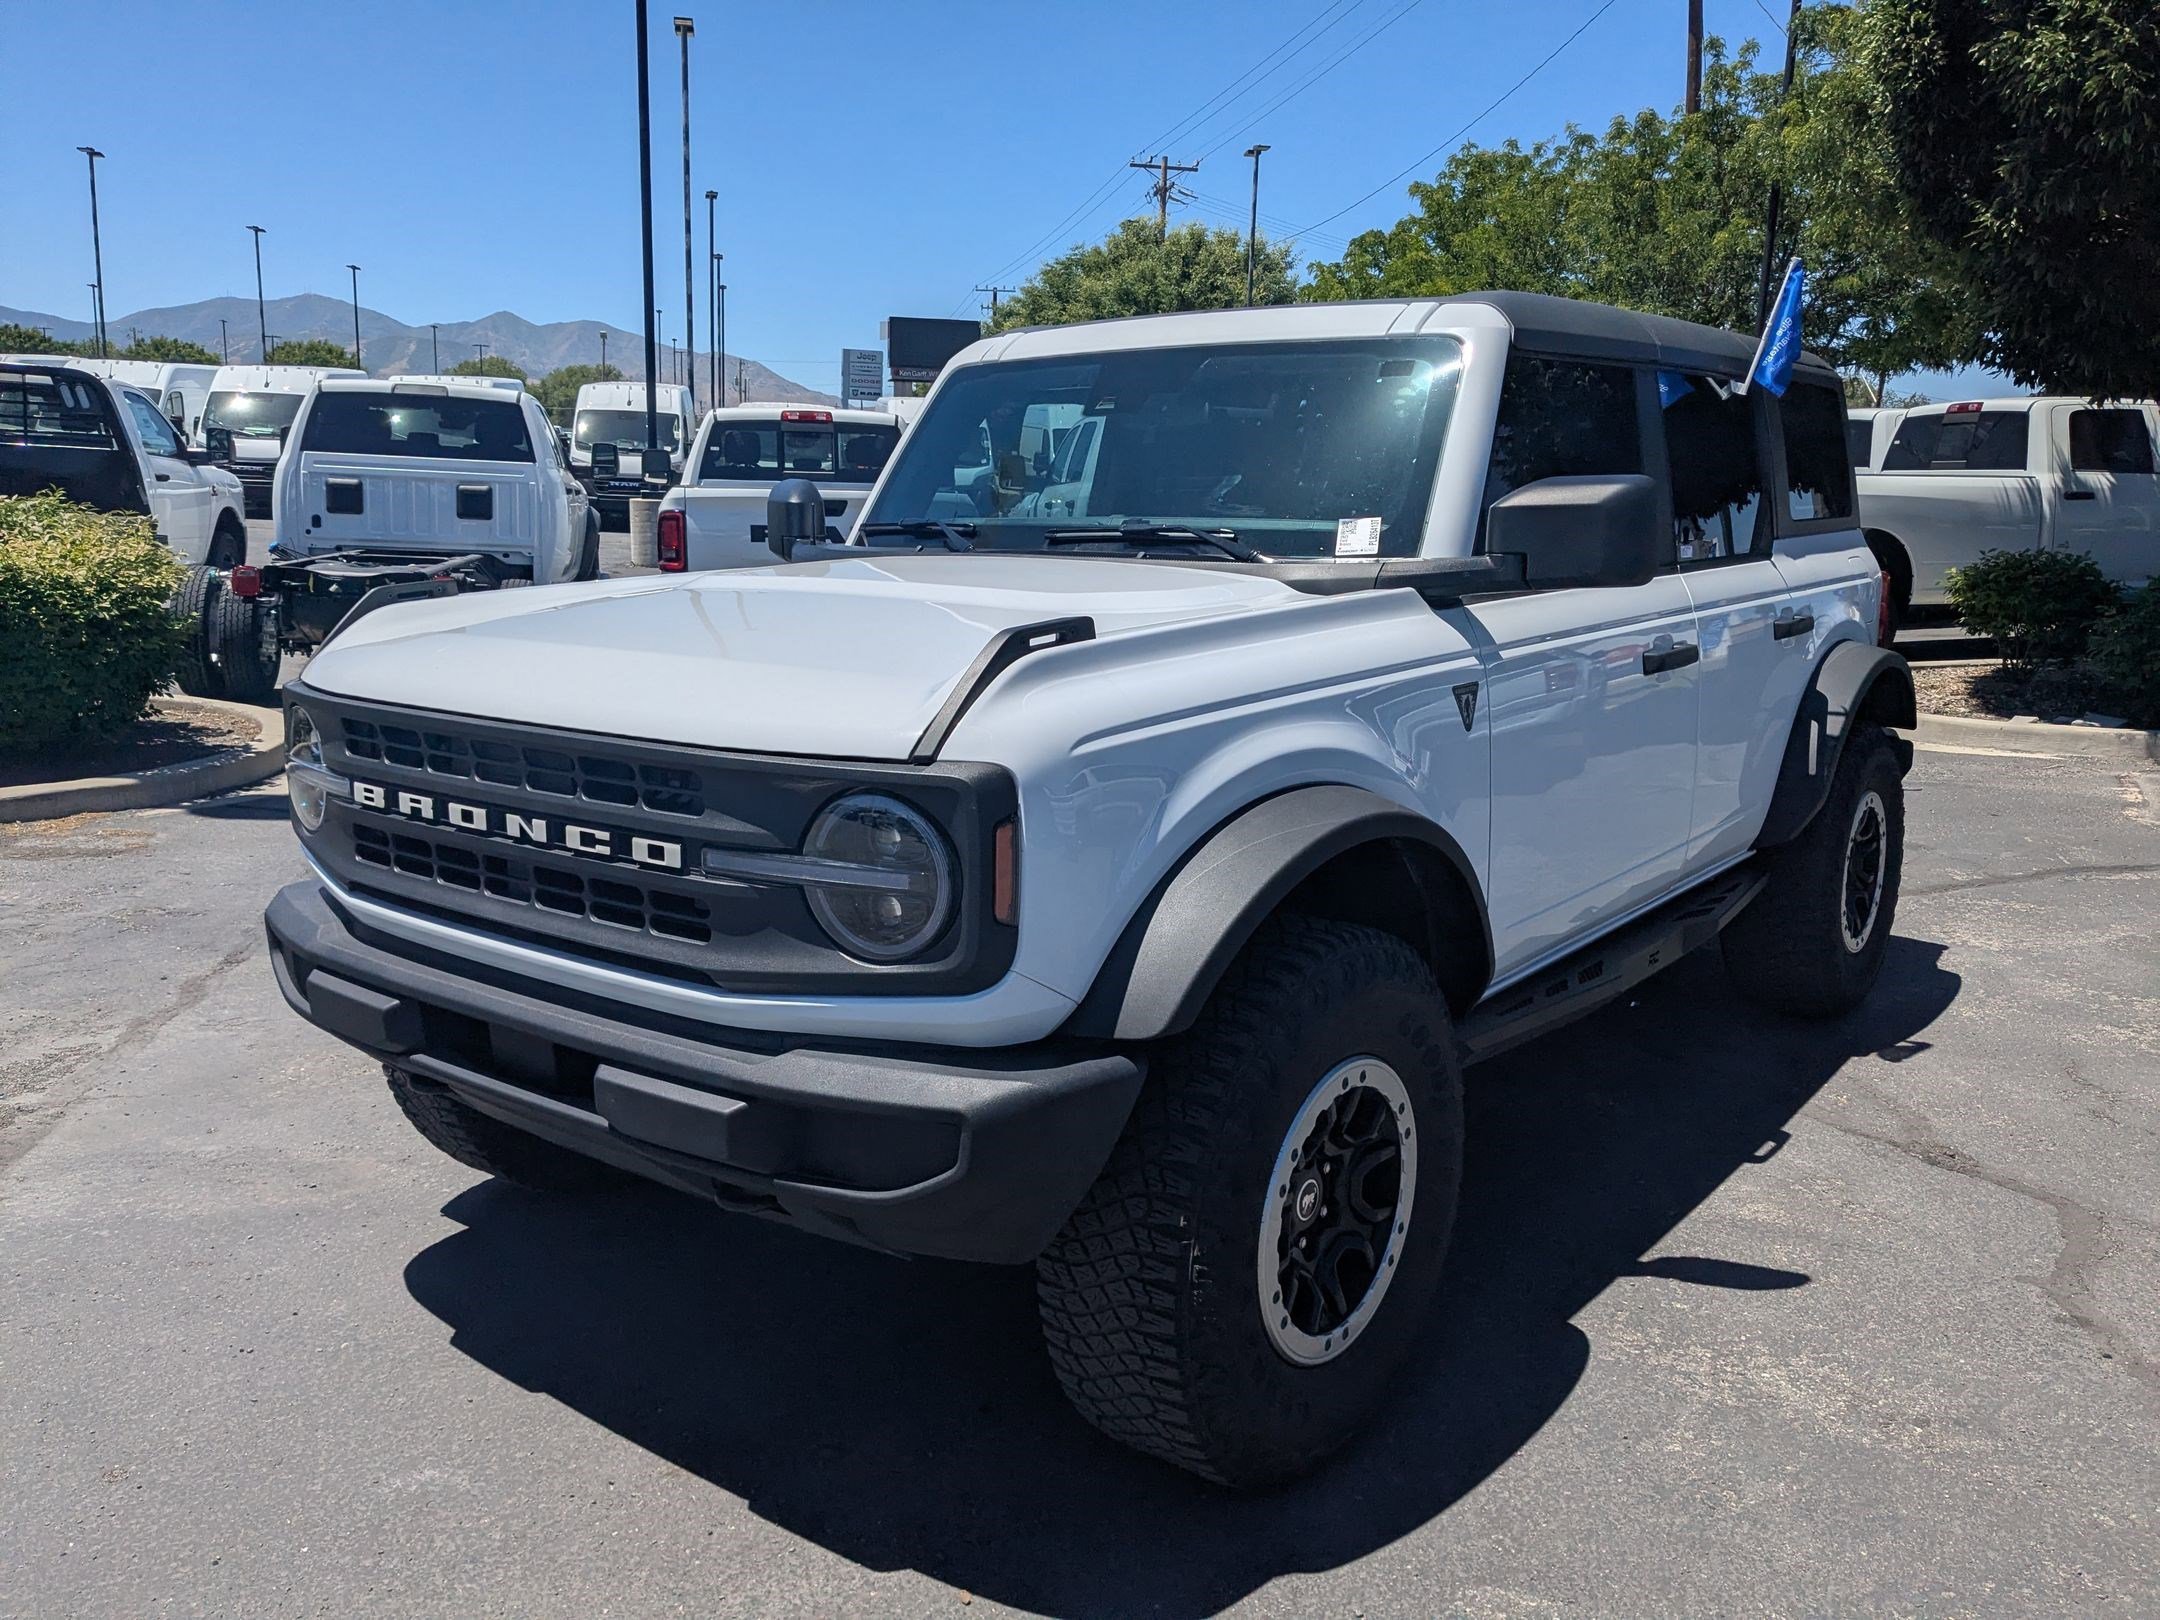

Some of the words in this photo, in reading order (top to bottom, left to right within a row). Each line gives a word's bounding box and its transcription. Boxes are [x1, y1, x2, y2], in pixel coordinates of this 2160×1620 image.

[856, 352, 877, 362] Jeep
[898, 369, 912, 377] Ken
[353, 781, 682, 869] BRONCO
